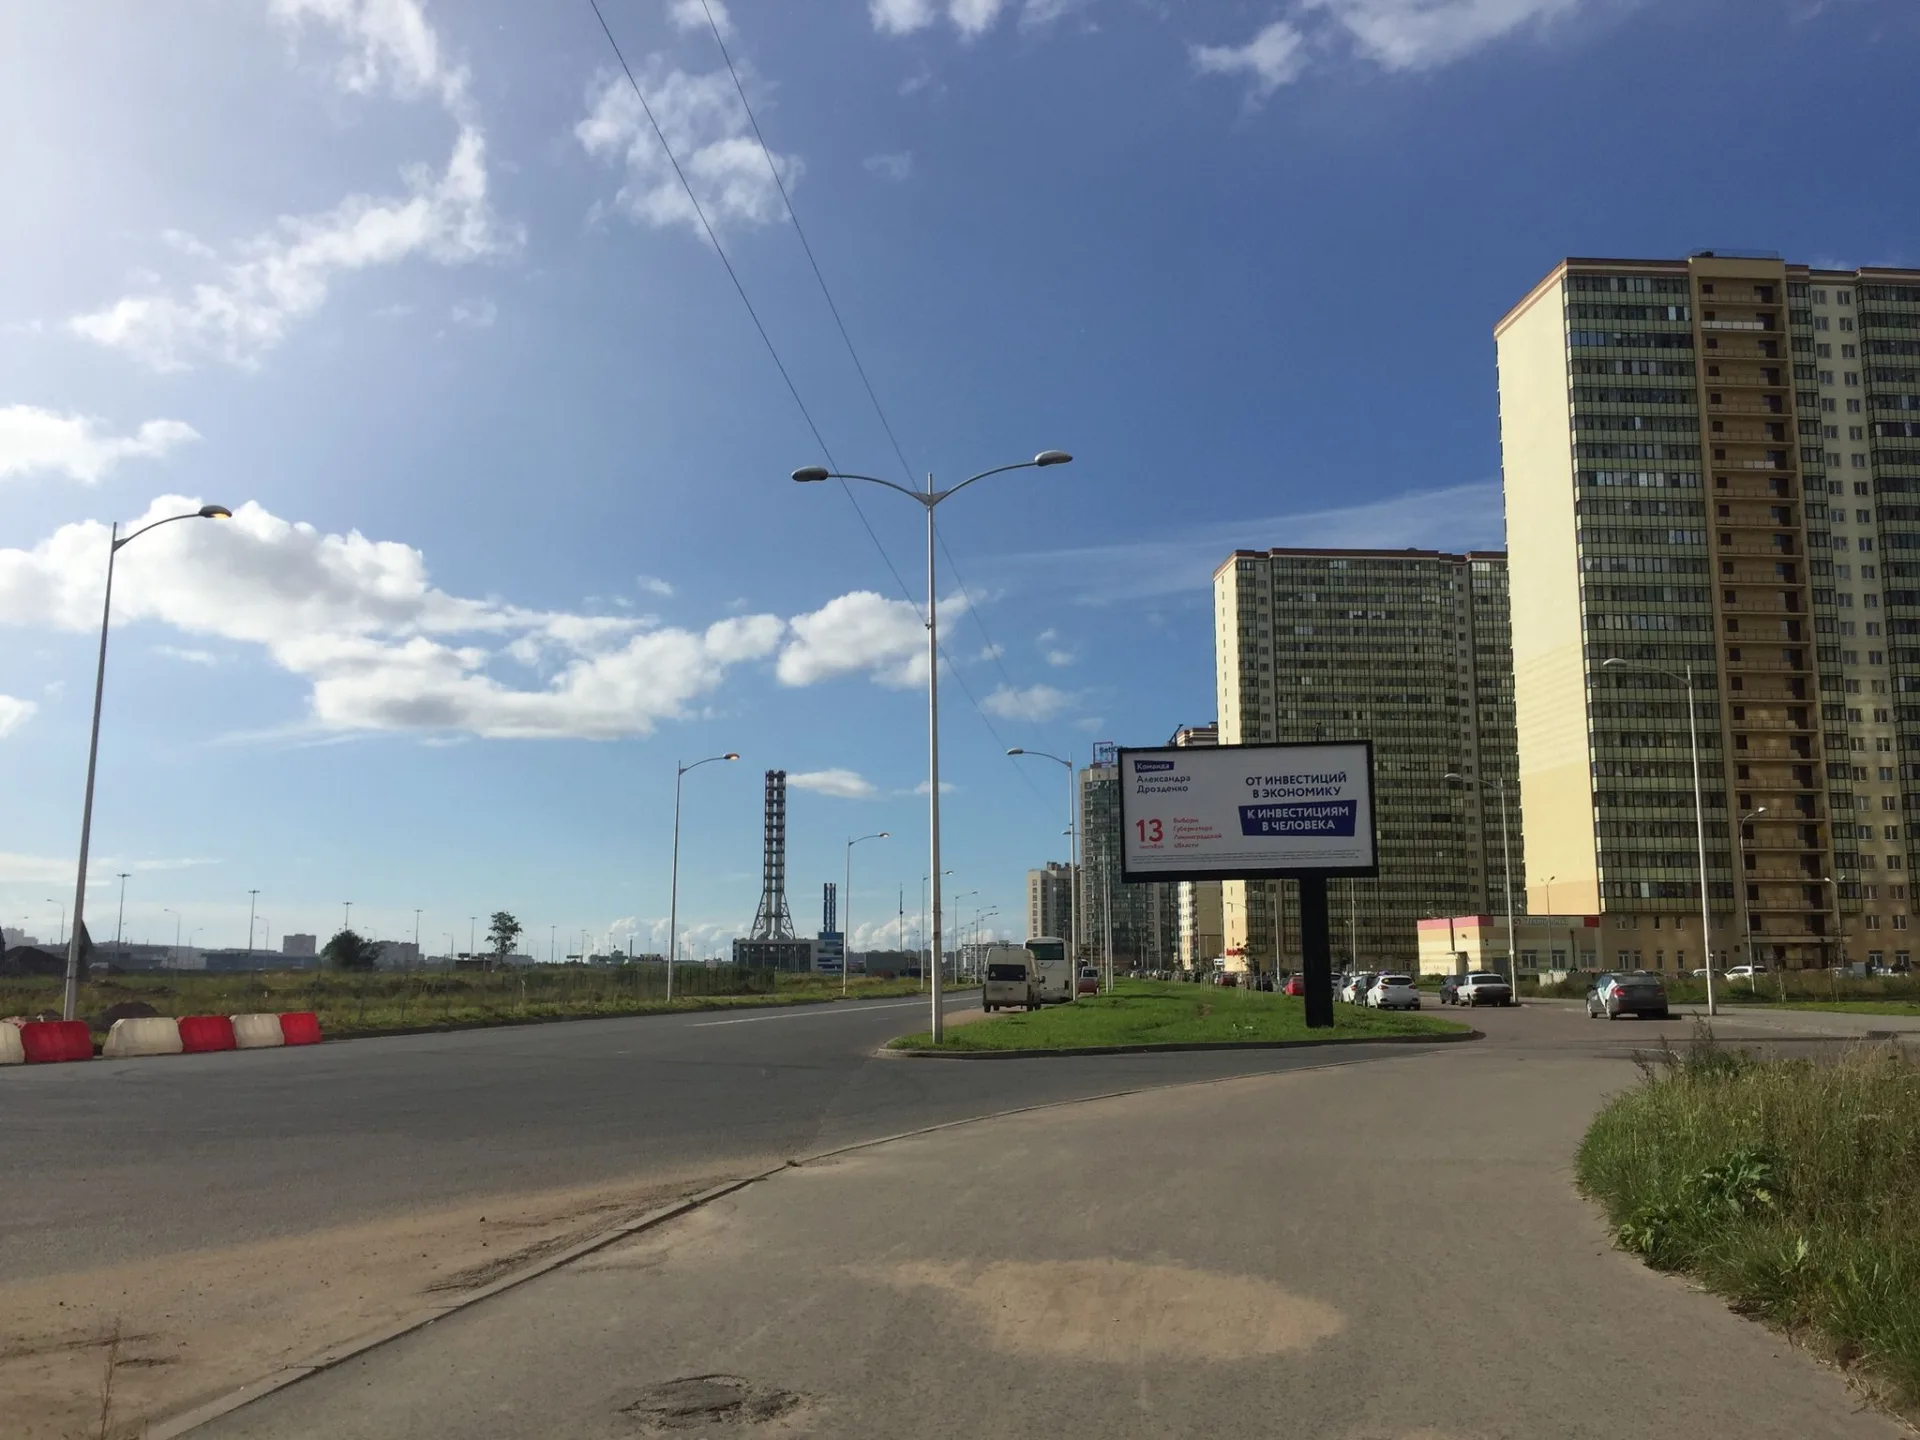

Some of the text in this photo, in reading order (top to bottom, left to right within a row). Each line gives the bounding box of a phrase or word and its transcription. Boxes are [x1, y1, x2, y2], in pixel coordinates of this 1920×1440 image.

[1137, 762, 1170, 771] Команда
[1136, 775, 1191, 784] Александра
[1245, 771, 1347, 786] ОТ ИНВЕСТИЦИЙ
[1136, 785, 1189, 795] Дрозденко
[1252, 786, 1341, 799] В ЭКОНОМИКУ
[1247, 806, 1349, 819] К ИНВЕСТИЦИЯМ
[1136, 818, 1164, 843] 13
[1262, 820, 1336, 832] В ЧЕЛОВЕКА
